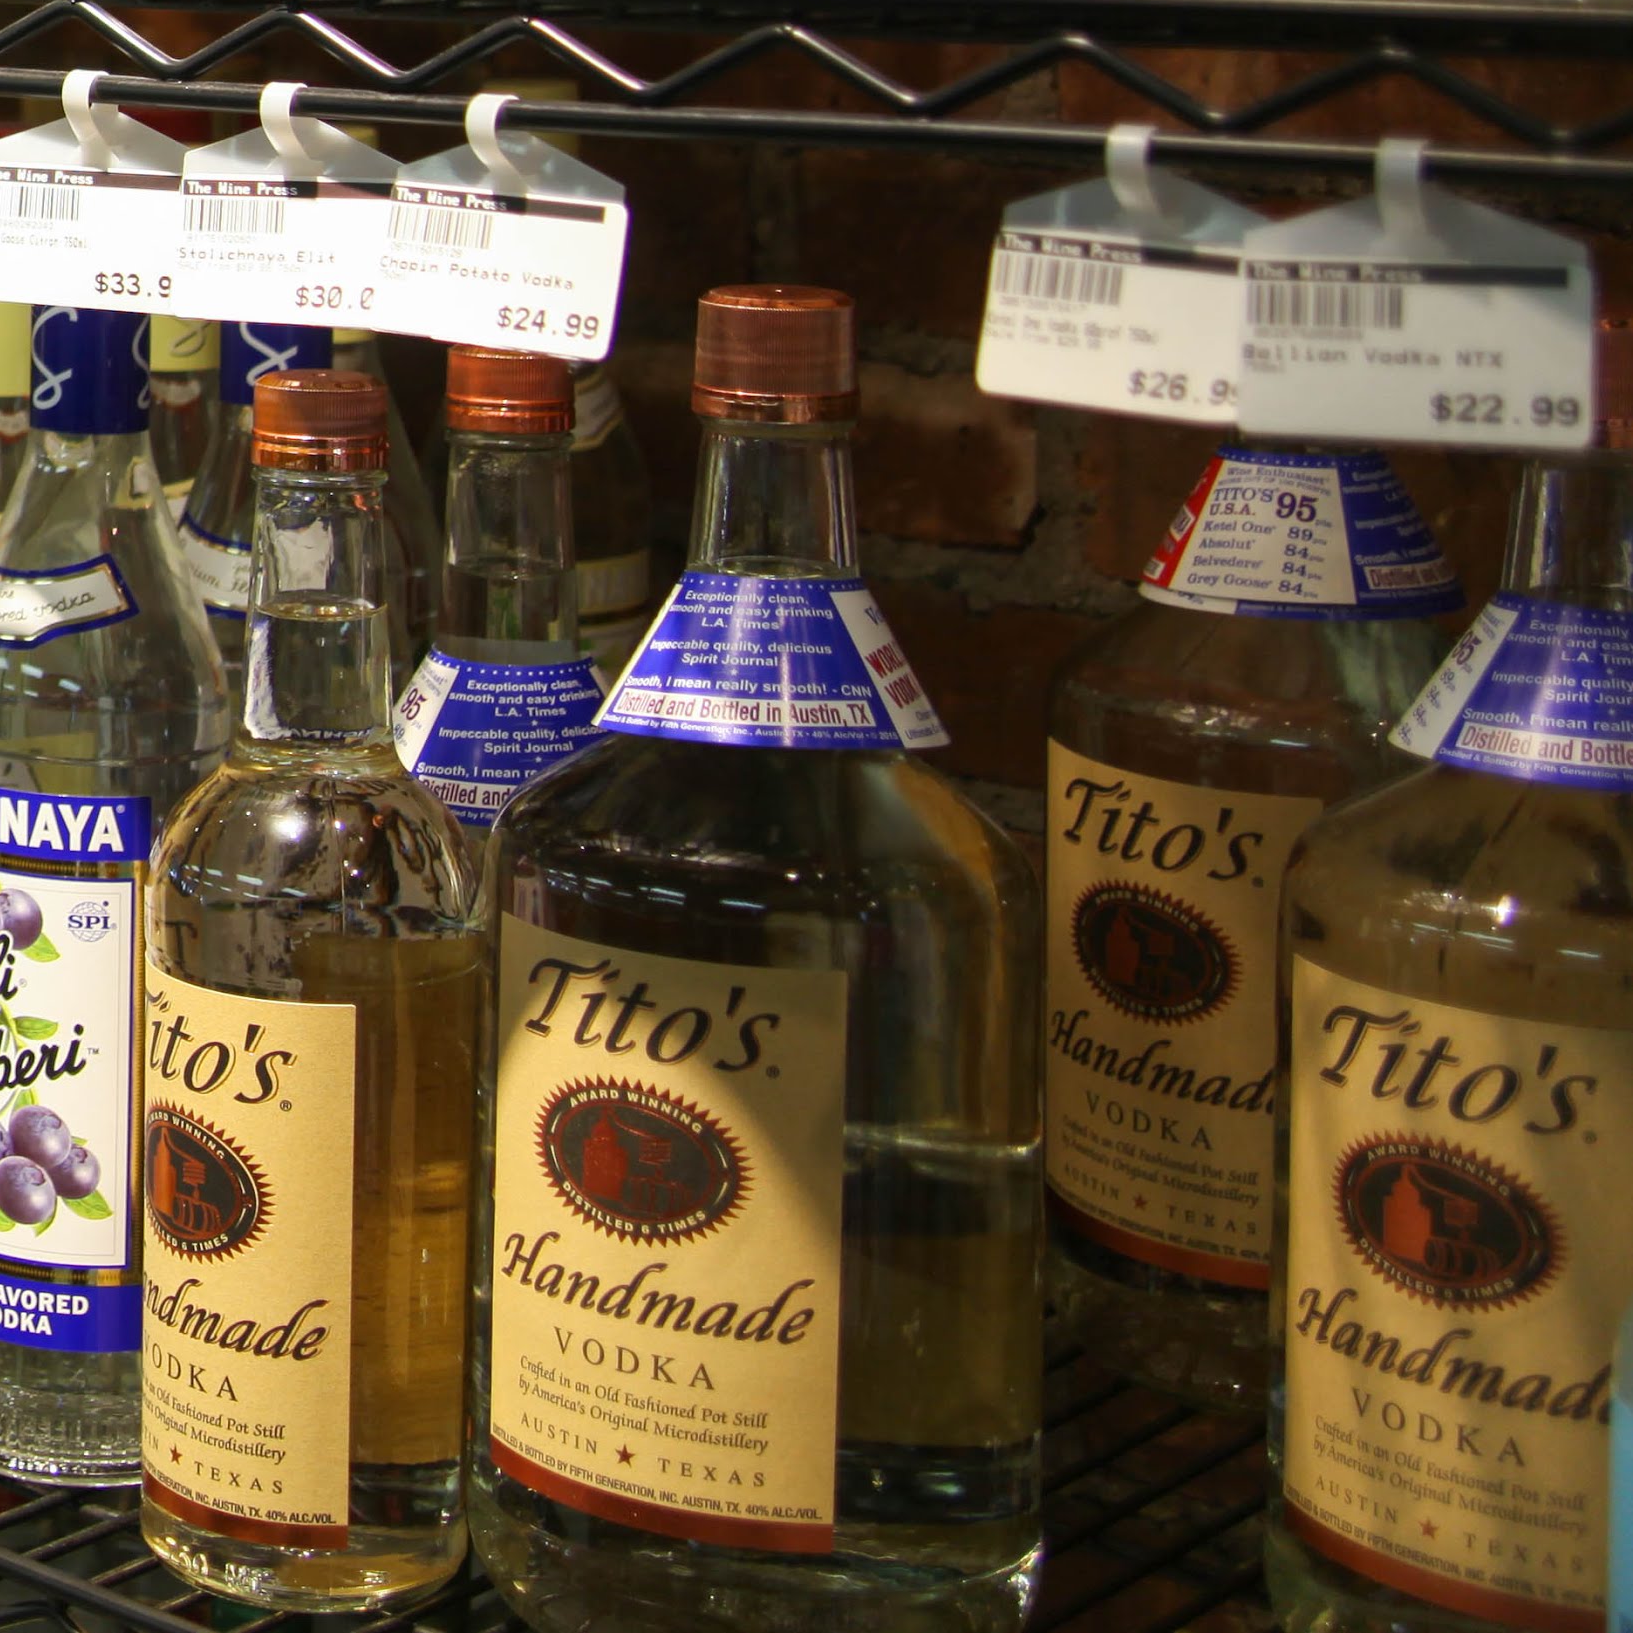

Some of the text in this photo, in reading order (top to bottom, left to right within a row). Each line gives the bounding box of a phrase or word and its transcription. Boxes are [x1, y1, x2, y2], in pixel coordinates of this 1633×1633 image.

[53, 170, 95, 186] Press
[256, 182, 299, 198] Press
[396, 186, 508, 212] The Wine Press
[94, 271, 173, 299] $33.9
[380, 255, 575, 292] Chopin Potato Vodka
[294, 284, 375, 311] $30.0
[496, 304, 600, 341] $24.99
[1429, 392, 1582, 428] $22.99
[1275, 490, 1319, 523] 95
[449, 691, 556, 707] smooth and easy
[467, 679, 548, 693] Exceptionally
[673, 678, 873, 699] mean CNN
[527, 707, 567, 717] Times
[666, 696, 697, 718] and
[847, 703, 872, 725] TX
[438, 727, 509, 741] Impeccable
[483, 741, 574, 754] Spirit Journal
[1537, 736, 1574, 762] and
[482, 769, 520, 779] mean
[1062, 776, 1265, 883] Tito's
[524, 954, 780, 1076] Tito's
[146, 988, 296, 1108] ito's
[1050, 1008, 1276, 1116] Handmad
[1320, 1003, 1600, 1138] Tito's
[569, 1088, 704, 1135] AWARD WINNING
[1085, 1090, 1215, 1154] VODKA
[1365, 1140, 1512, 1199] AWARD WINNING
[561, 1180, 707, 1235] DISTILLED 6 TIMES
[190, 1232, 231, 1252] TIMES
[501, 1232, 816, 1346] Handmade
[144, 1276, 332, 1363] ndmade
[553, 1325, 716, 1392] VODKA
[519, 1354, 769, 1430] Crafted in an Old Fashioned Pot Still
[226, 1416, 250, 1435] Pot
[252, 1422, 287, 1441] Still
[517, 1372, 532, 1396] by
[589, 1404, 649, 1434] Original
[652, 1419, 770, 1457] Microdistillery
[1351, 1386, 1527, 1468] VODKA
[190, 1425, 287, 1466] Microdistillery
[520, 1410, 767, 1489] AUSTIN TEXAS
[193, 1459, 284, 1496] TEXAS
[744, 1503, 770, 1519] 40%
